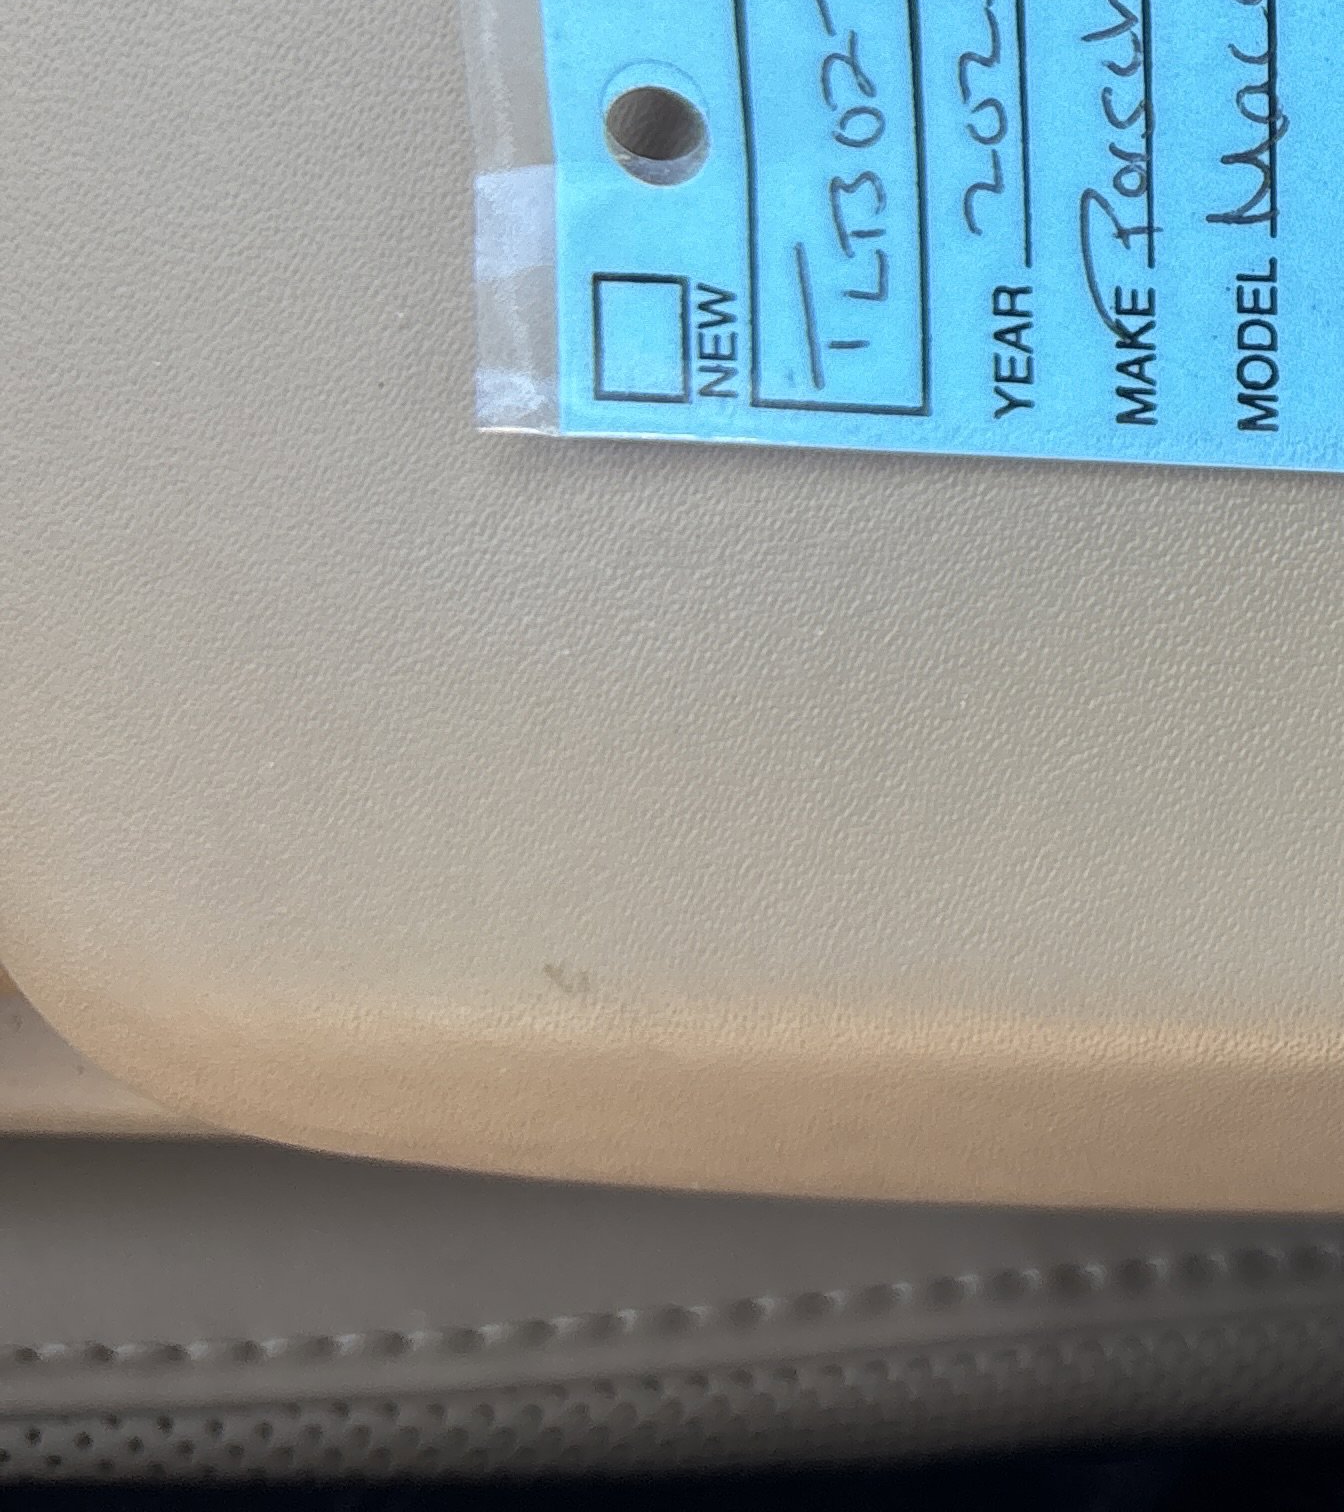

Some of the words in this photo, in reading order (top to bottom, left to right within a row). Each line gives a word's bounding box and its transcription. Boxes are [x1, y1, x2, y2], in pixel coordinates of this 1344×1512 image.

[696, 283, 737, 399] NEW
[993, 286, 1033, 418] YEAR
[1115, 286, 1156, 425] MAKE
[1237, 258, 1279, 431] MODEL
